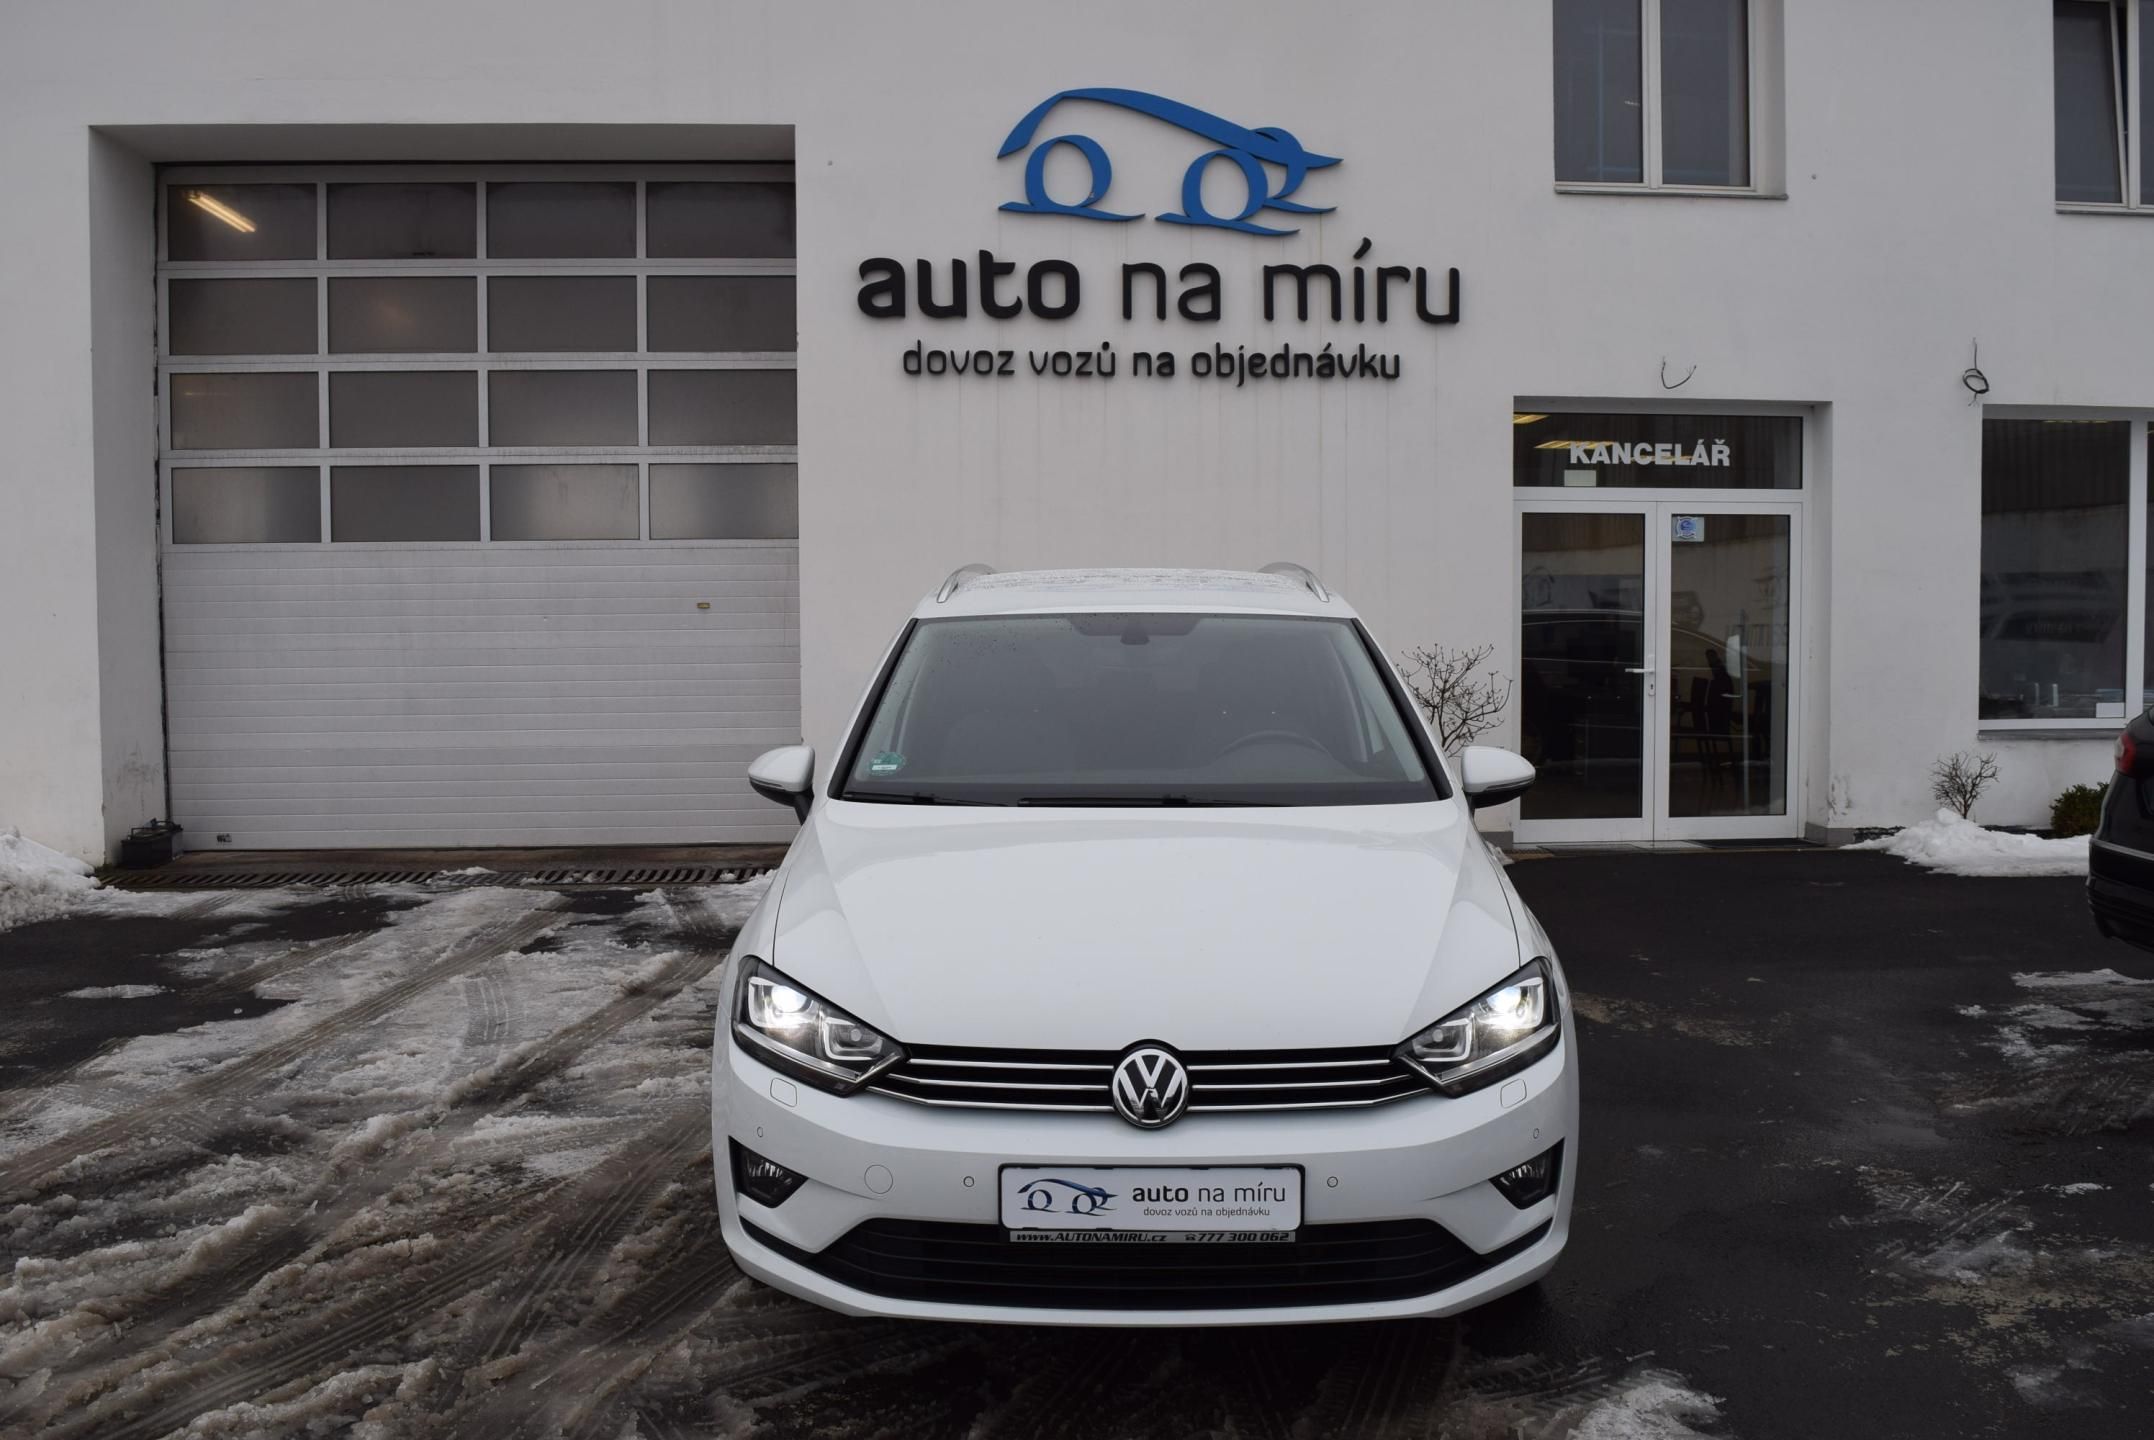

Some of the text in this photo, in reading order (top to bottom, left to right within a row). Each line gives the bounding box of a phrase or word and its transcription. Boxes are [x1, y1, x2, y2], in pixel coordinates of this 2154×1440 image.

[857, 236, 1461, 324] auto na míru
[903, 340, 1401, 388] dovoz vozů na objednávku
[1569, 438, 1731, 467] KANCELÁŘ
[1132, 1181, 1286, 1202] auto na míru
[1143, 1206, 1270, 1218] dovoz vozů na objednávku
[1198, 1232, 1225, 1242] 777
[1227, 1232, 1257, 1242] 300
[1259, 1232, 1290, 1242] 062
